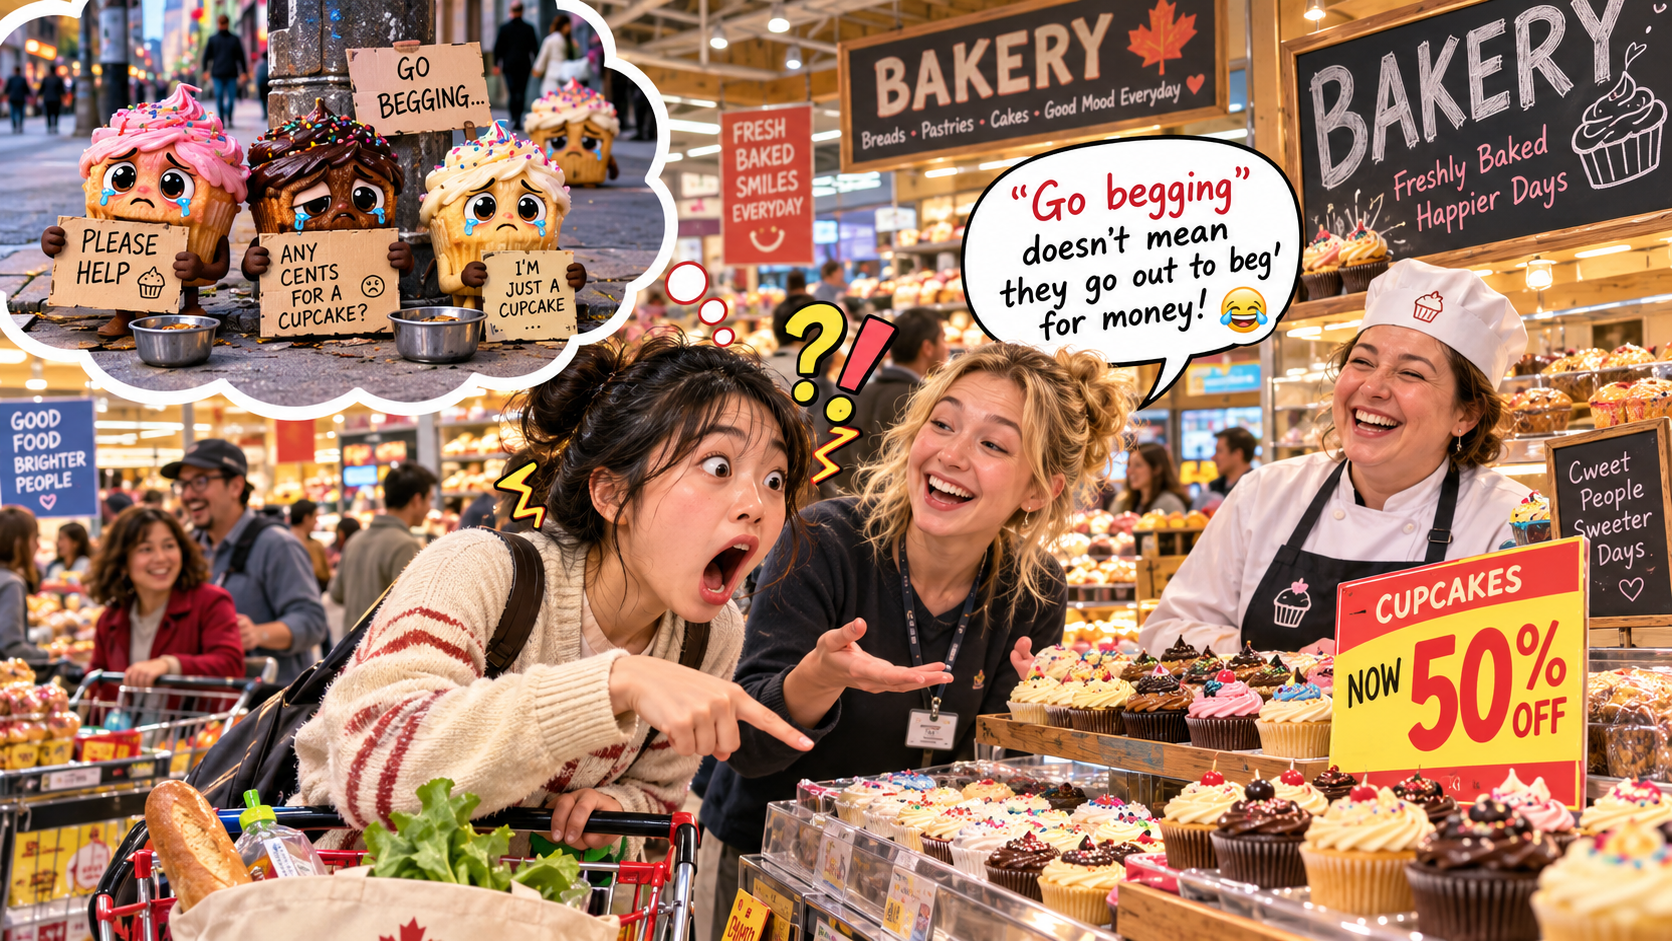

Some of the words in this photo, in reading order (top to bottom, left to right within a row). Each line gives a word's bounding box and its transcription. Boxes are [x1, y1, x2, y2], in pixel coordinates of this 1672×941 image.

[397, 56, 430, 81] GO
[874, 12, 1114, 119] BAKERY
[377, 84, 485, 119] BEGGING...
[1310, 0, 1625, 190] BAKERY
[861, 126, 906, 150] Breads
[921, 116, 975, 141] Pastries
[990, 107, 1029, 129] Cakes
[1044, 99, 1077, 120] Good
[1082, 90, 1115, 113] Mood
[1120, 80, 1181, 110] Everyday
[732, 117, 786, 145] FRESH
[735, 143, 795, 172] BAKED
[1393, 155, 1466, 202] Freshly
[1477, 124, 1549, 175] Baked
[736, 170, 799, 198] SMILES
[732, 196, 804, 223] EVERYDAY
[1416, 190, 1501, 233] Happier
[1511, 171, 1569, 209] Days
[81, 228, 159, 255] PLEASE
[280, 242, 318, 265] ANY
[76, 260, 131, 285] HELP
[280, 264, 339, 287] CENTS
[515, 259, 539, 276] I'M
[291, 289, 324, 308] FOR
[330, 288, 342, 302] A
[506, 280, 542, 298] JUST
[549, 278, 560, 293] A
[278, 303, 368, 330] CUPCAKE?
[499, 297, 565, 318] CUPCAKE
[10, 408, 61, 431] GOOD
[12, 430, 62, 453] FOOD
[14, 450, 87, 474] BRIGHTER
[1568, 451, 1631, 486] Cweet
[15, 471, 73, 495] PEOPLE
[1579, 478, 1645, 511] People
[1573, 509, 1653, 538] Sweeter
[1375, 564, 1522, 625] CUPCAKES
[1348, 657, 1402, 708] NOW
[1512, 696, 1567, 738] OFF
